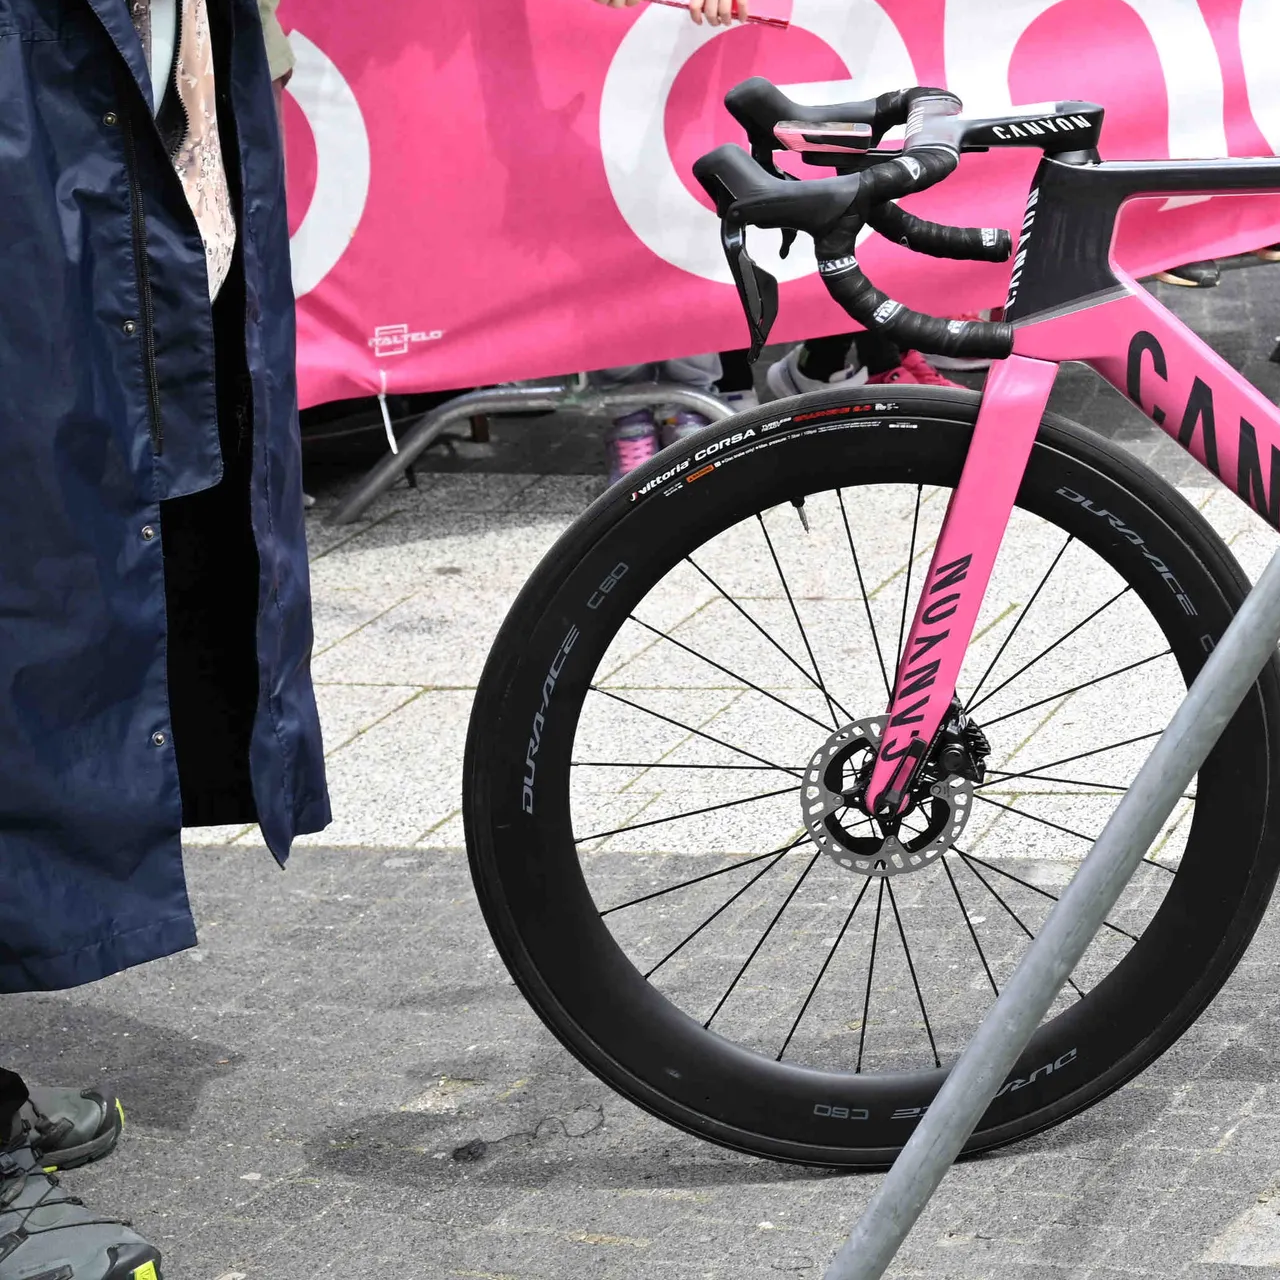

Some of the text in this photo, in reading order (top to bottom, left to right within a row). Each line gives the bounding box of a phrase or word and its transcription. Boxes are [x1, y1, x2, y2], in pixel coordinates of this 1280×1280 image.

[992, 114, 1093, 141] CANYON
[637, 457, 690, 496] vittoria
[694, 428, 756, 461] CORSA
[1055, 486, 1198, 617] DURA-ACE
[880, 552, 973, 763] CANYON
[522, 624, 580, 815] DURA-ACE
[813, 1104, 870, 1121] C60
